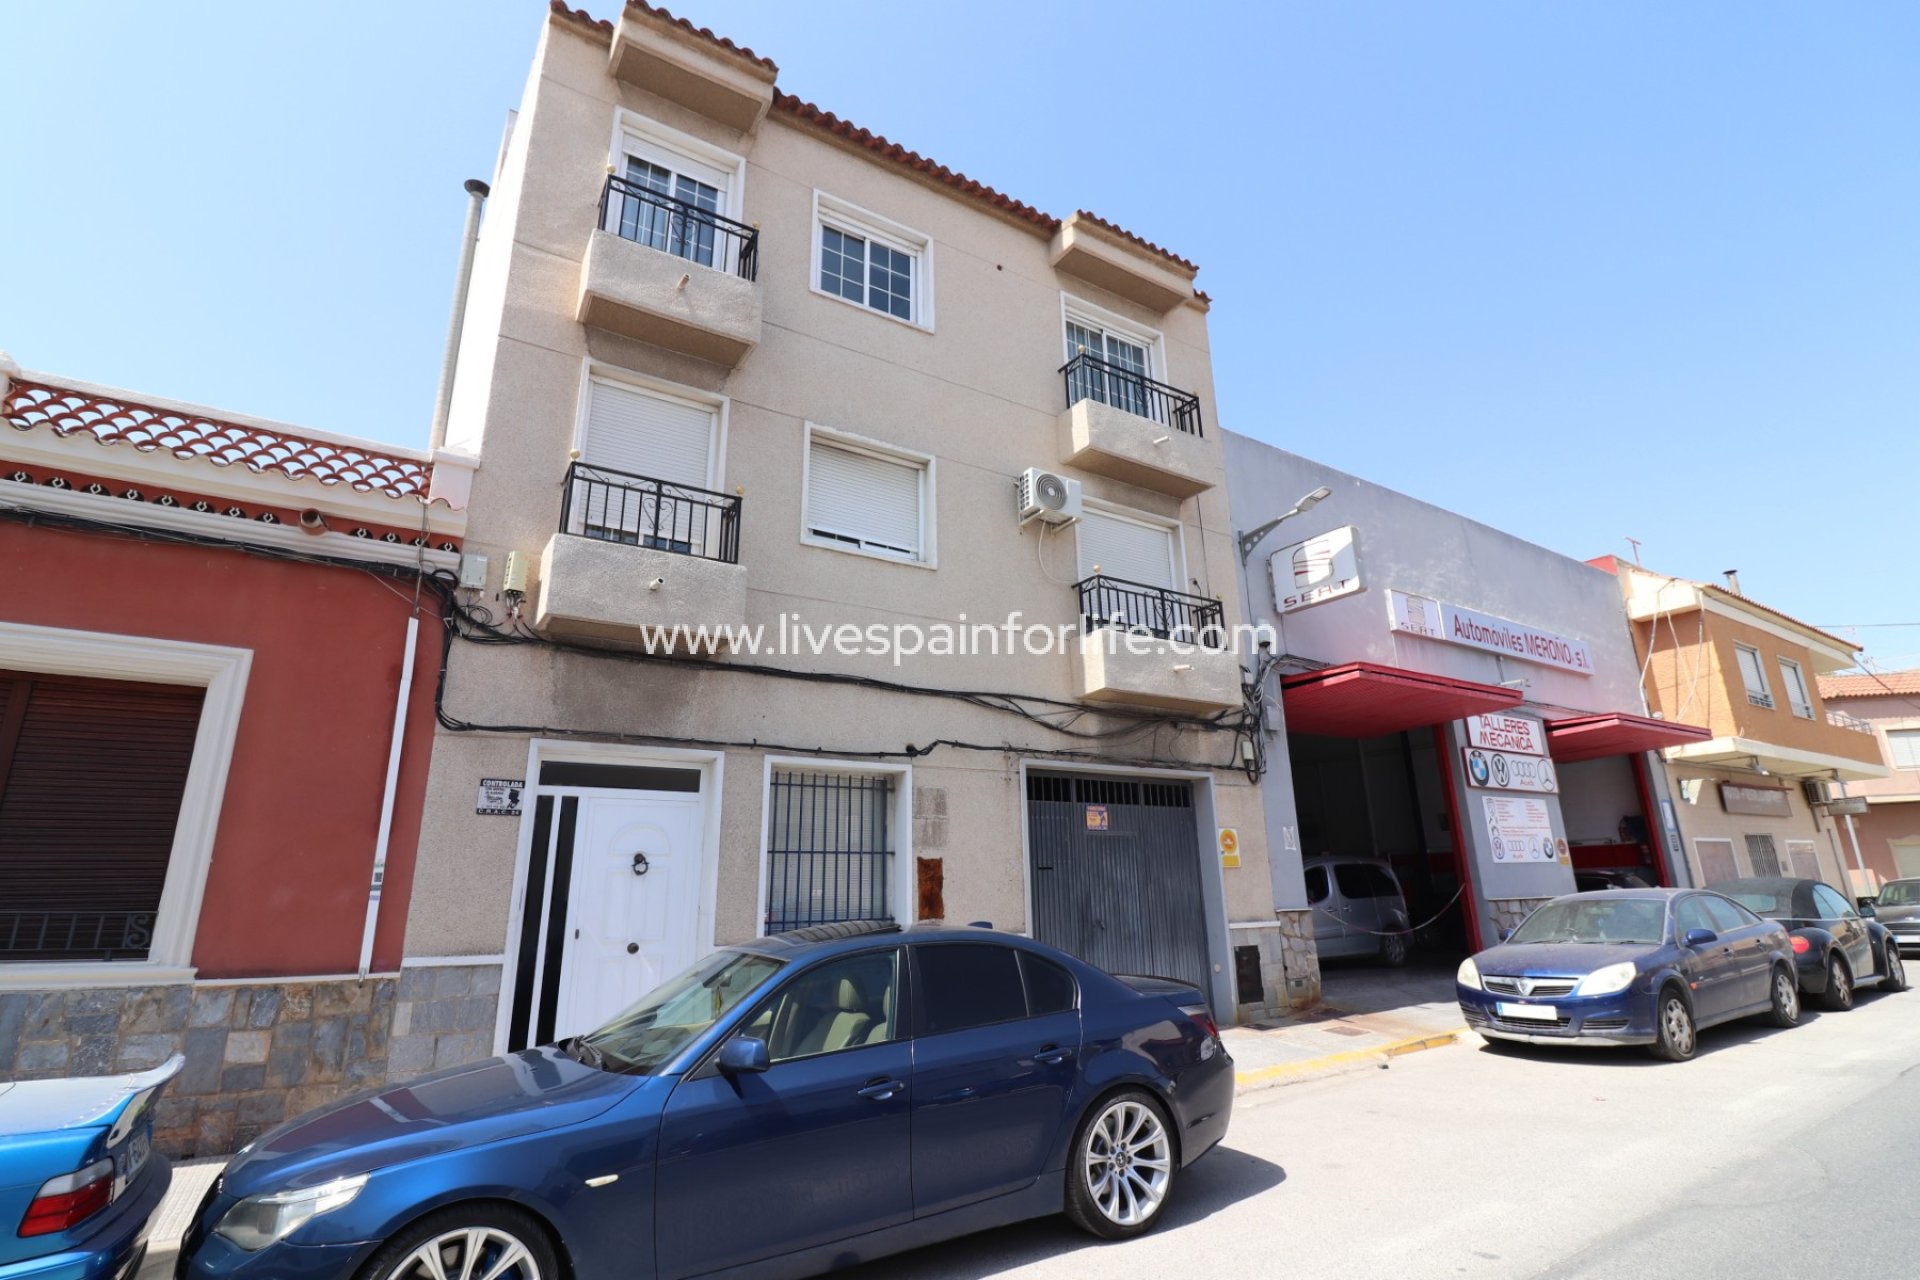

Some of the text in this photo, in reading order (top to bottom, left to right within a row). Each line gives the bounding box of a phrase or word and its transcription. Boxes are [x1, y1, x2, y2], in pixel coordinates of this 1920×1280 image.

[1283, 578, 1351, 608] SEAT
[1400, 621, 1435, 636] SEAT
[1480, 715, 1531, 736] TALLERES
